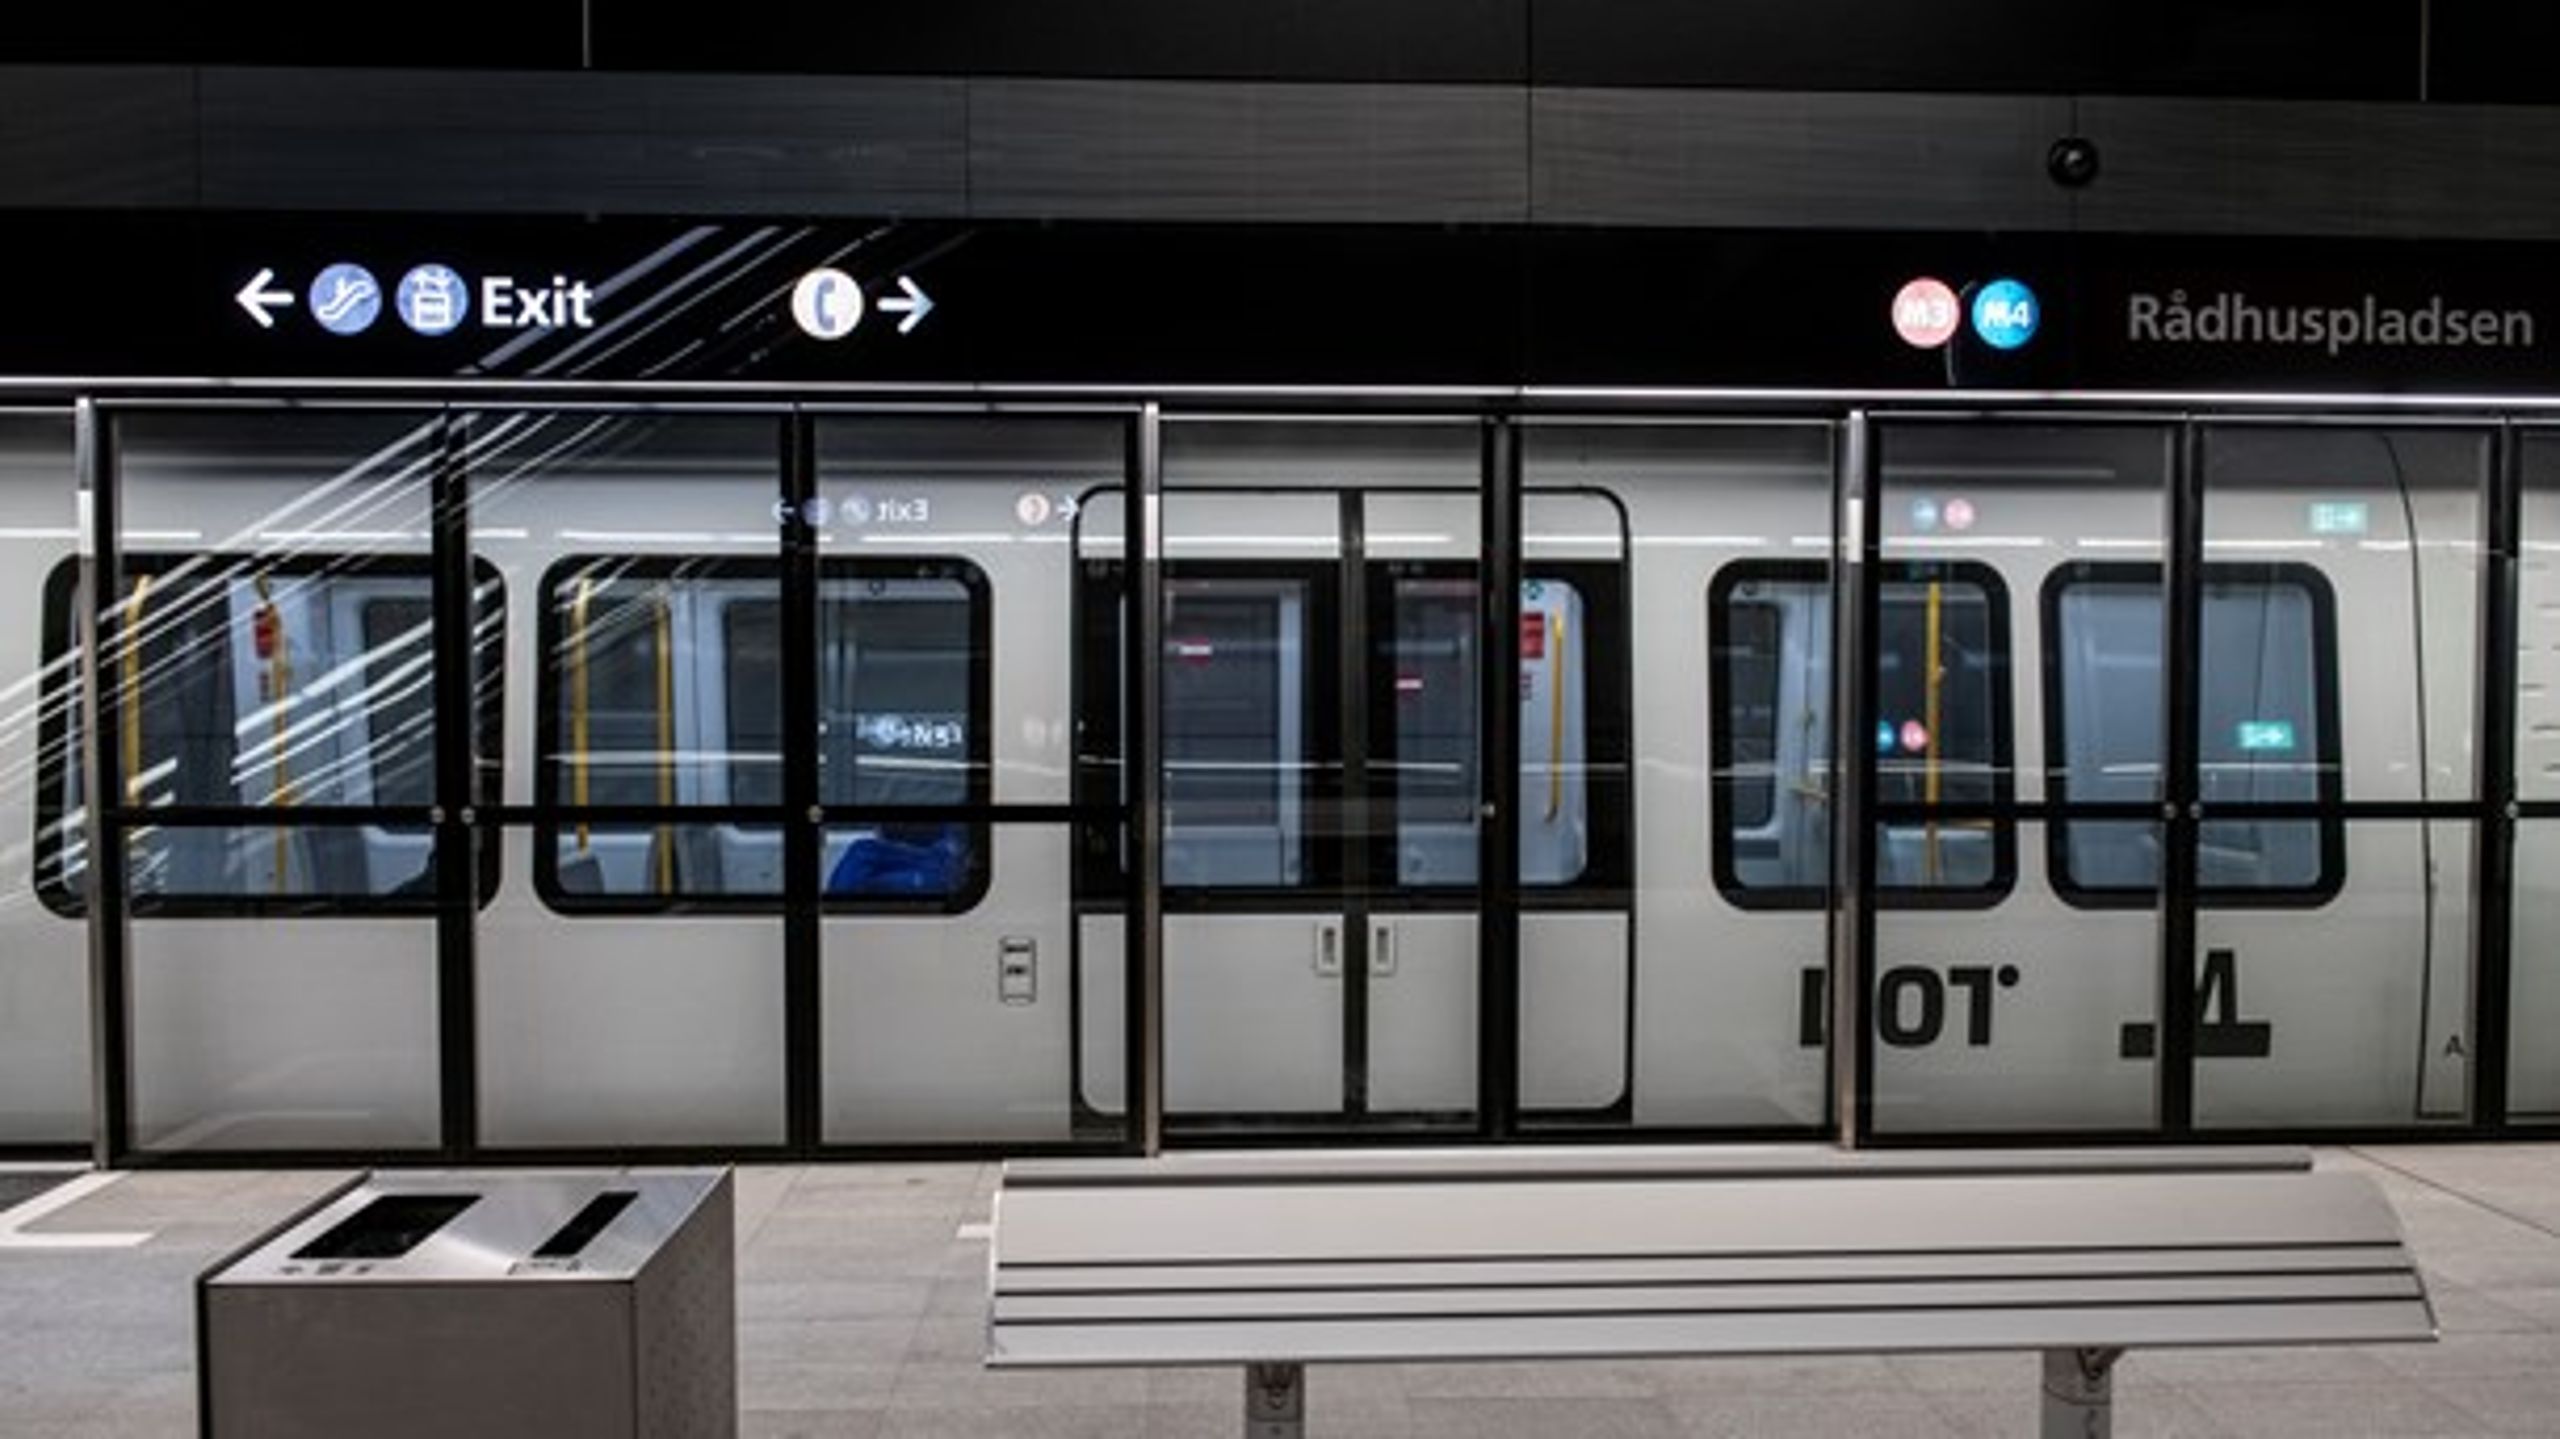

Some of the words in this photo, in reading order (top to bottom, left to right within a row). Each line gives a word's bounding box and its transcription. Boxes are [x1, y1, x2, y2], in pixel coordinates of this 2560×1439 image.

[481, 276, 594, 328] Exit
[1903, 298, 1951, 330] M3
[1983, 300, 2034, 331] M4
[2128, 289, 2534, 355] Rådhuspladsen
[2444, 1034, 2466, 1057] A
